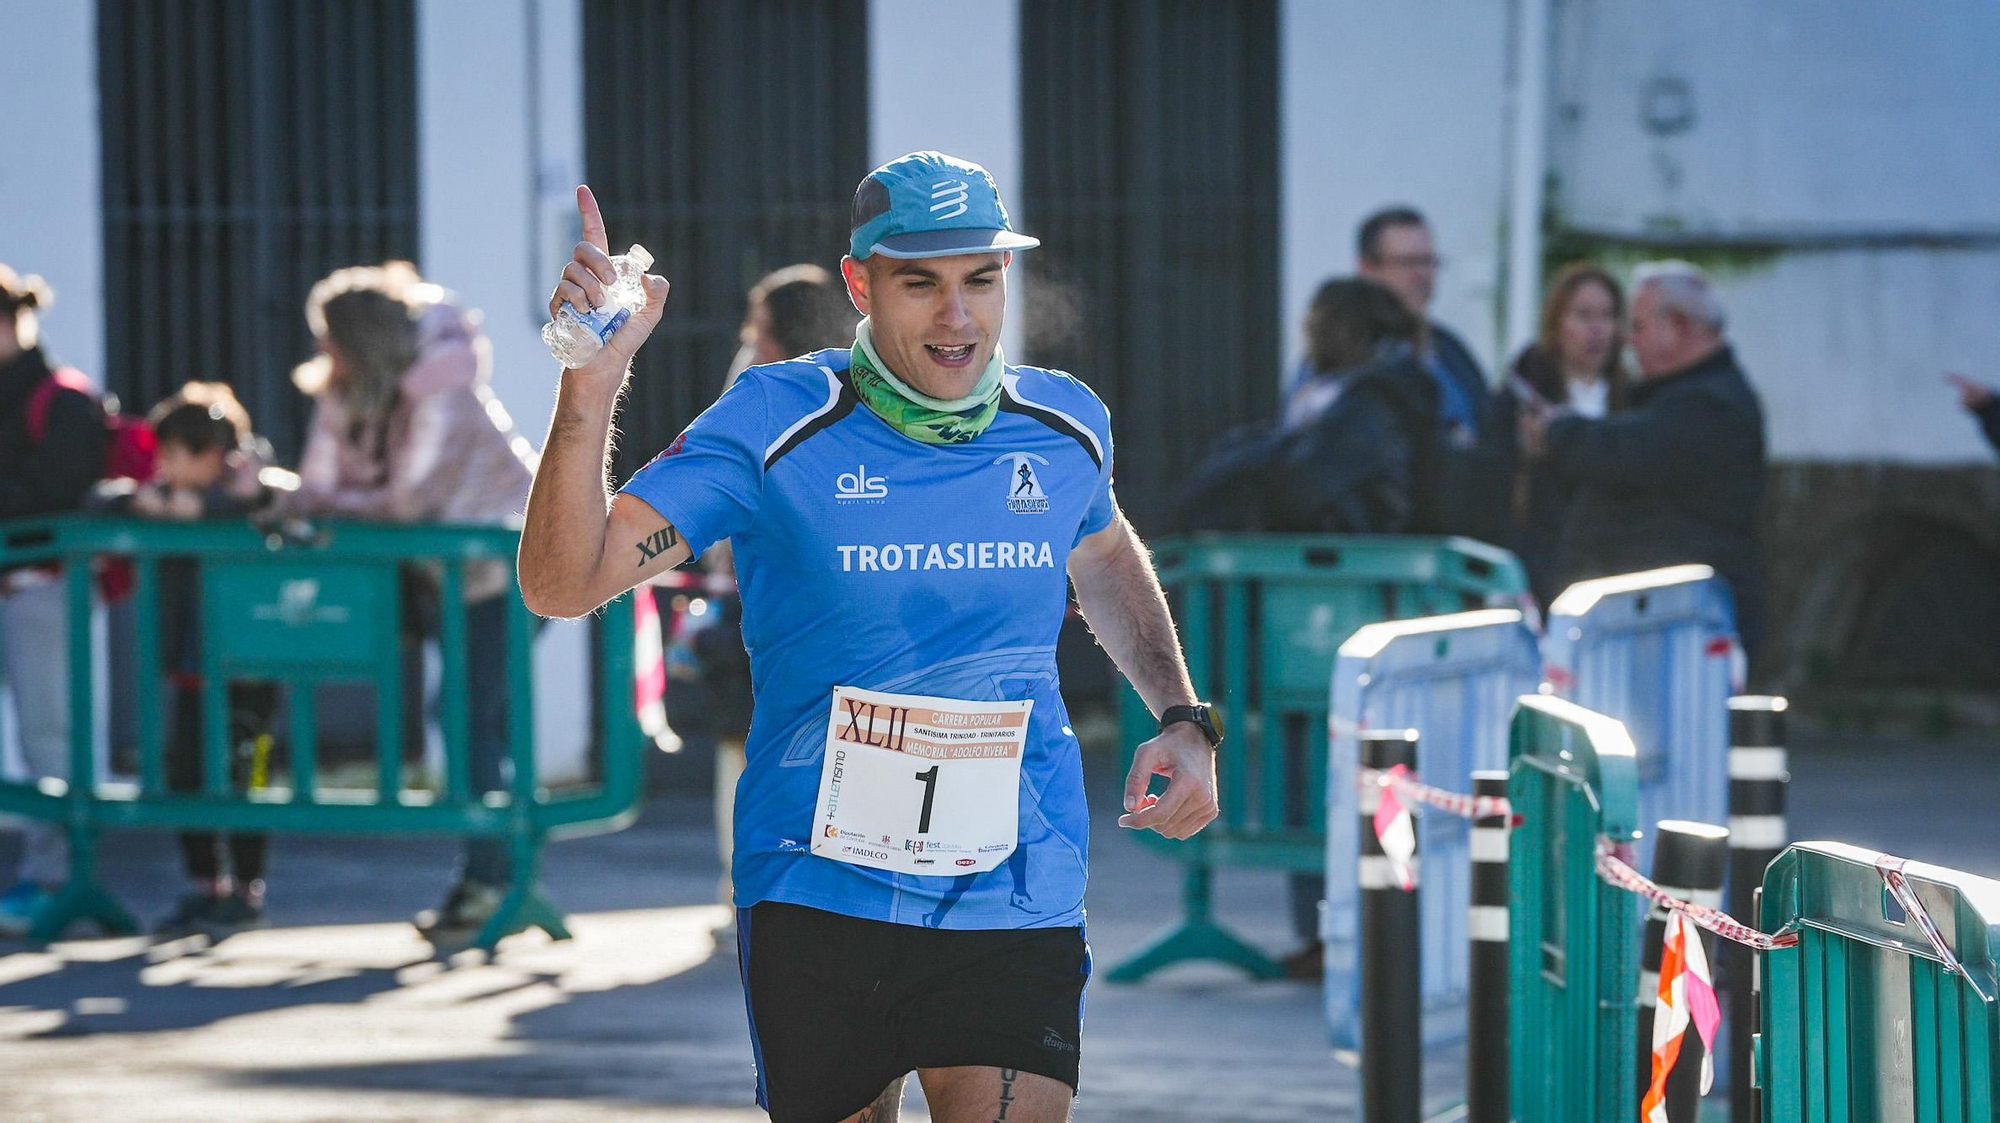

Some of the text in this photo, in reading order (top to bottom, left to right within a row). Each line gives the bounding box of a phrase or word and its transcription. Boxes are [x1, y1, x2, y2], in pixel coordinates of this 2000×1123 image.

[835, 465, 888, 498] als
[636, 524, 677, 567] XIII
[836, 541, 1055, 572] TROTASIERRA
[839, 698, 910, 752] XLII
[931, 712, 1002, 726] CARRERA POPULAR
[914, 727, 948, 739] SANTISIMA
[949, 732, 977, 740] TRINIDAD
[980, 730, 1016, 738] TRINITARIOS
[905, 741, 948, 758] MEMORIAL
[914, 765, 940, 834] 1
[852, 846, 888, 860] IMDECO
[926, 841, 941, 849] fest
